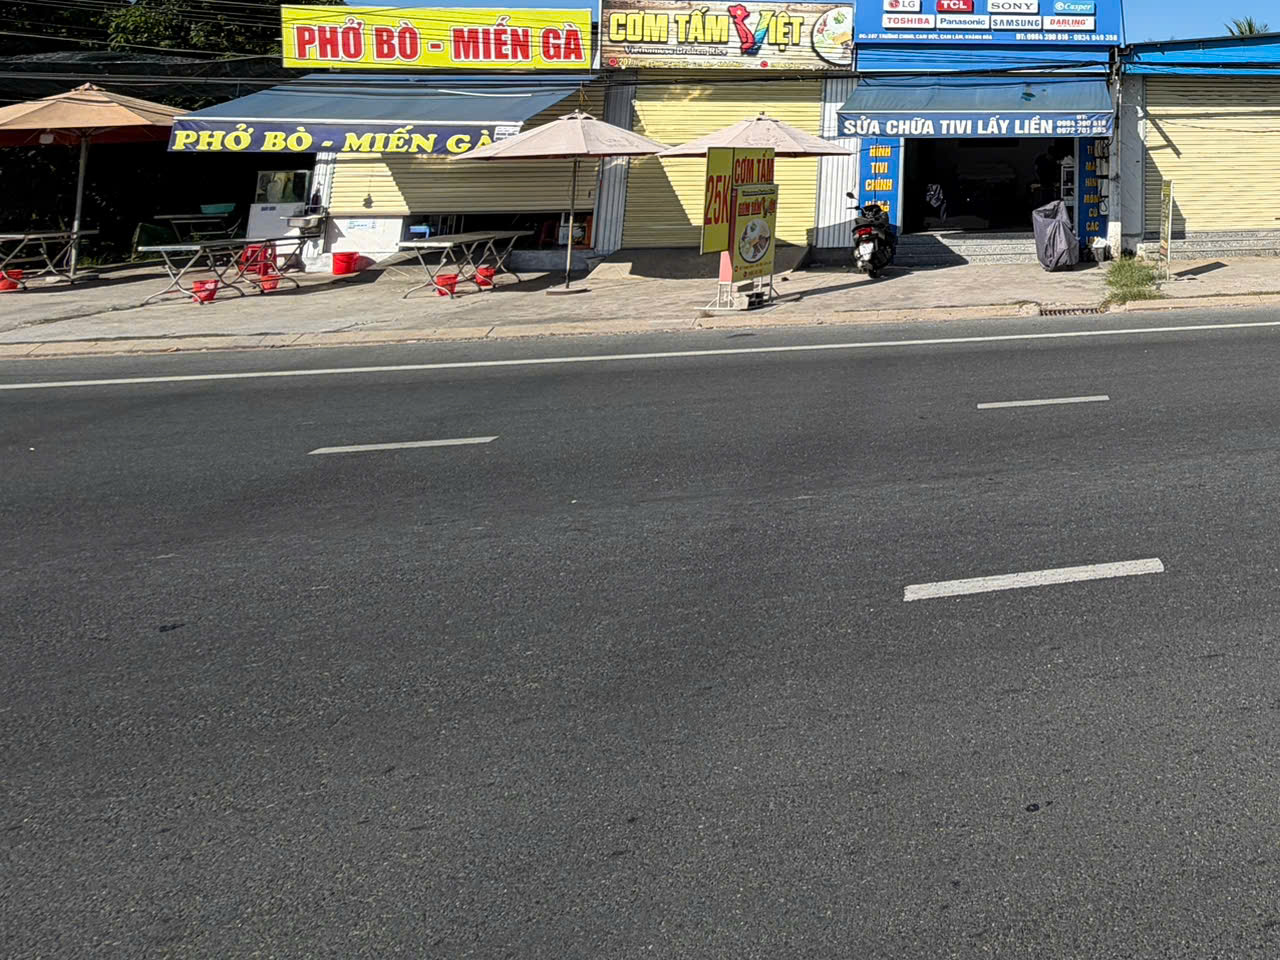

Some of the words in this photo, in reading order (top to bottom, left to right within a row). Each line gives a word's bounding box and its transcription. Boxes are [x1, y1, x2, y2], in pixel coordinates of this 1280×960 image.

[901, 0, 916, 9] LG
[941, 0, 968, 10] TCL
[990, 1, 1034, 11] SONY
[1064, 1, 1092, 12] Casper
[609, 11, 669, 43] CƠM
[675, 7, 730, 44] TẤM
[887, 16, 930, 26] TOSHIBA
[940, 16, 986, 26] Panasonic
[992, 18, 1040, 28] SAMSUNG
[1049, 18, 1087, 27] DARLING
[295, 17, 364, 60] PHỞ
[374, 20, 420, 60] BÒ
[452, 16, 531, 61] MIẾN
[541, 22, 585, 61] GÀ
[844, 115, 880, 135] SỬA
[885, 117, 934, 135] CHỮA
[940, 120, 972, 135] TIVI
[977, 115, 1010, 135] LẤY
[1014, 115, 1053, 135] LIỀN
[172, 123, 253, 152] PHỞ
[261, 127, 313, 152] BÒ
[342, 126, 437, 153] MIẾN
[735, 156, 755, 184] CƠM
[757, 150, 774, 184] TẤM
[870, 162, 888, 174] TIVI
[865, 176, 893, 191] CHÍNH
[704, 175, 731, 225] 25K
